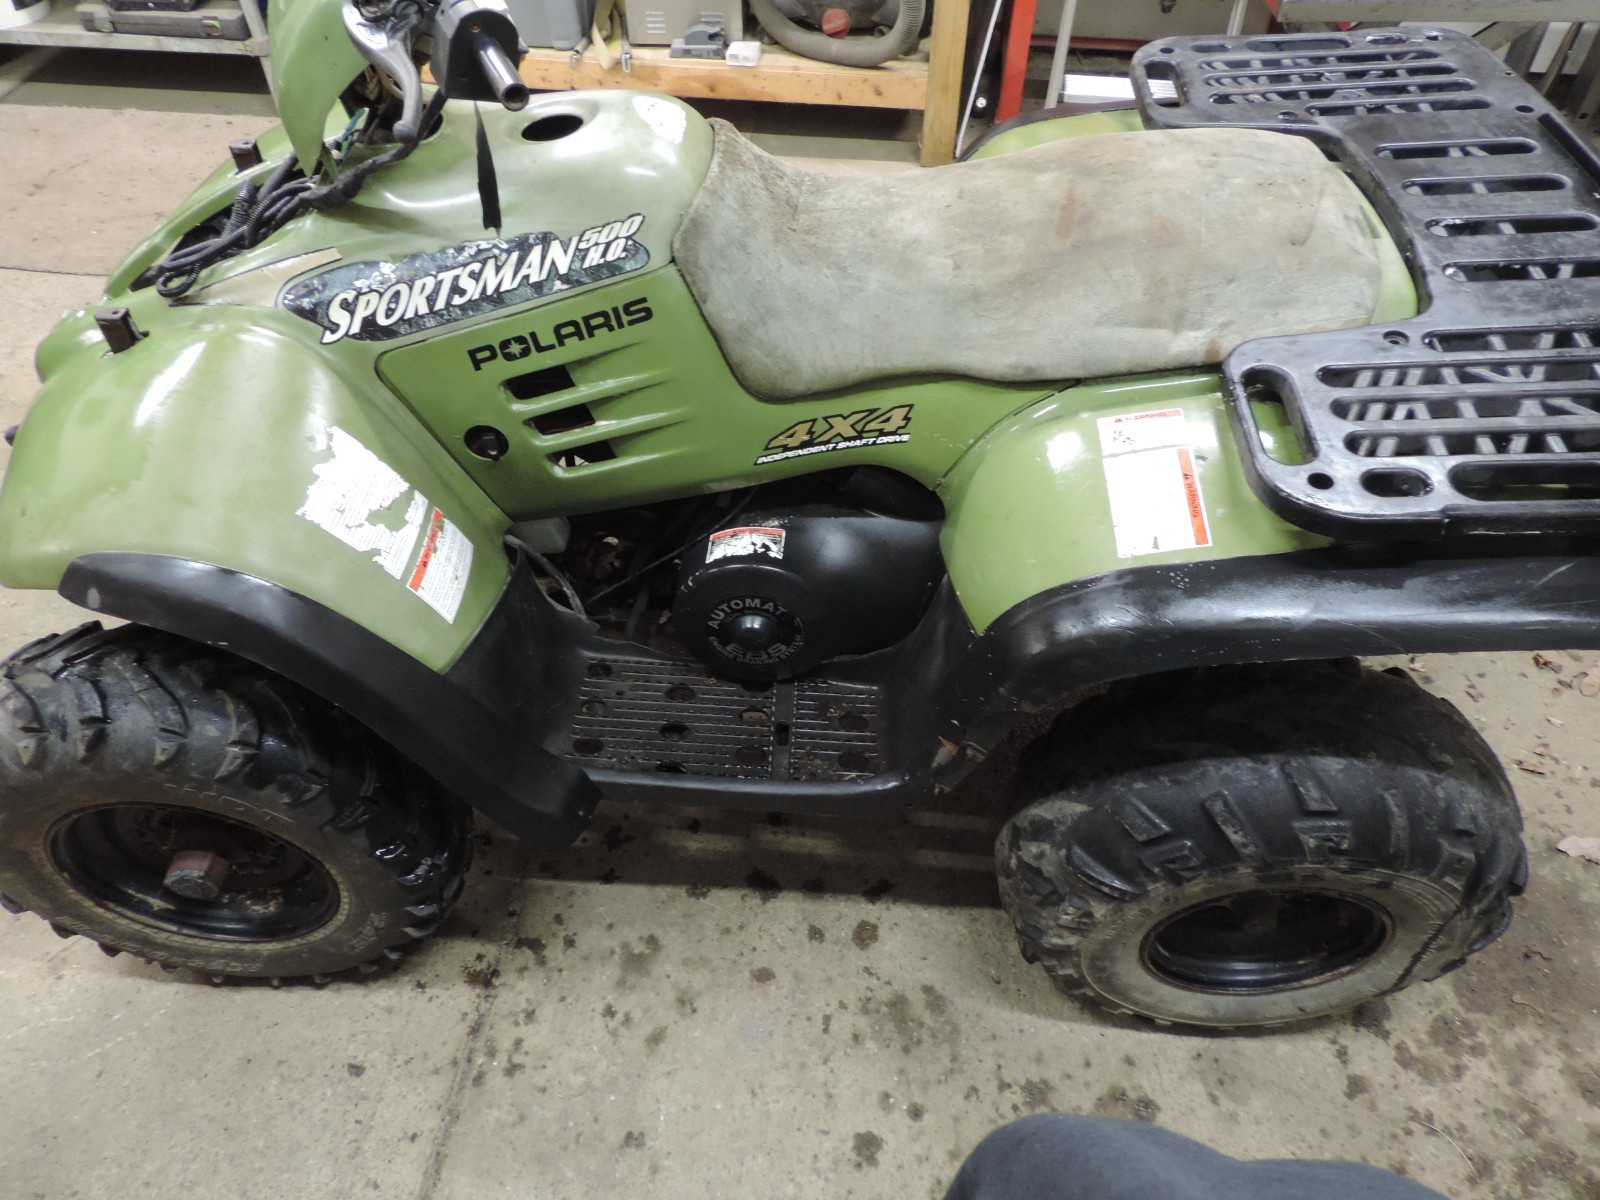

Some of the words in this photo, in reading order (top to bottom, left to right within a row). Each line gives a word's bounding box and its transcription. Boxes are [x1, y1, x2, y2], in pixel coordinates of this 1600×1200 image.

[582, 240, 628, 269] H.O.
[321, 236, 580, 344] SPORTSMAN
[578, 213, 645, 250] 500
[467, 296, 653, 371] POLARIS
[763, 404, 915, 451] 4X4
[756, 443, 836, 464] INDEPENDENT
[836, 438, 876, 449] SHAFT
[876, 435, 910, 445] DRIVE
[707, 598, 790, 631] AUTOMAT
